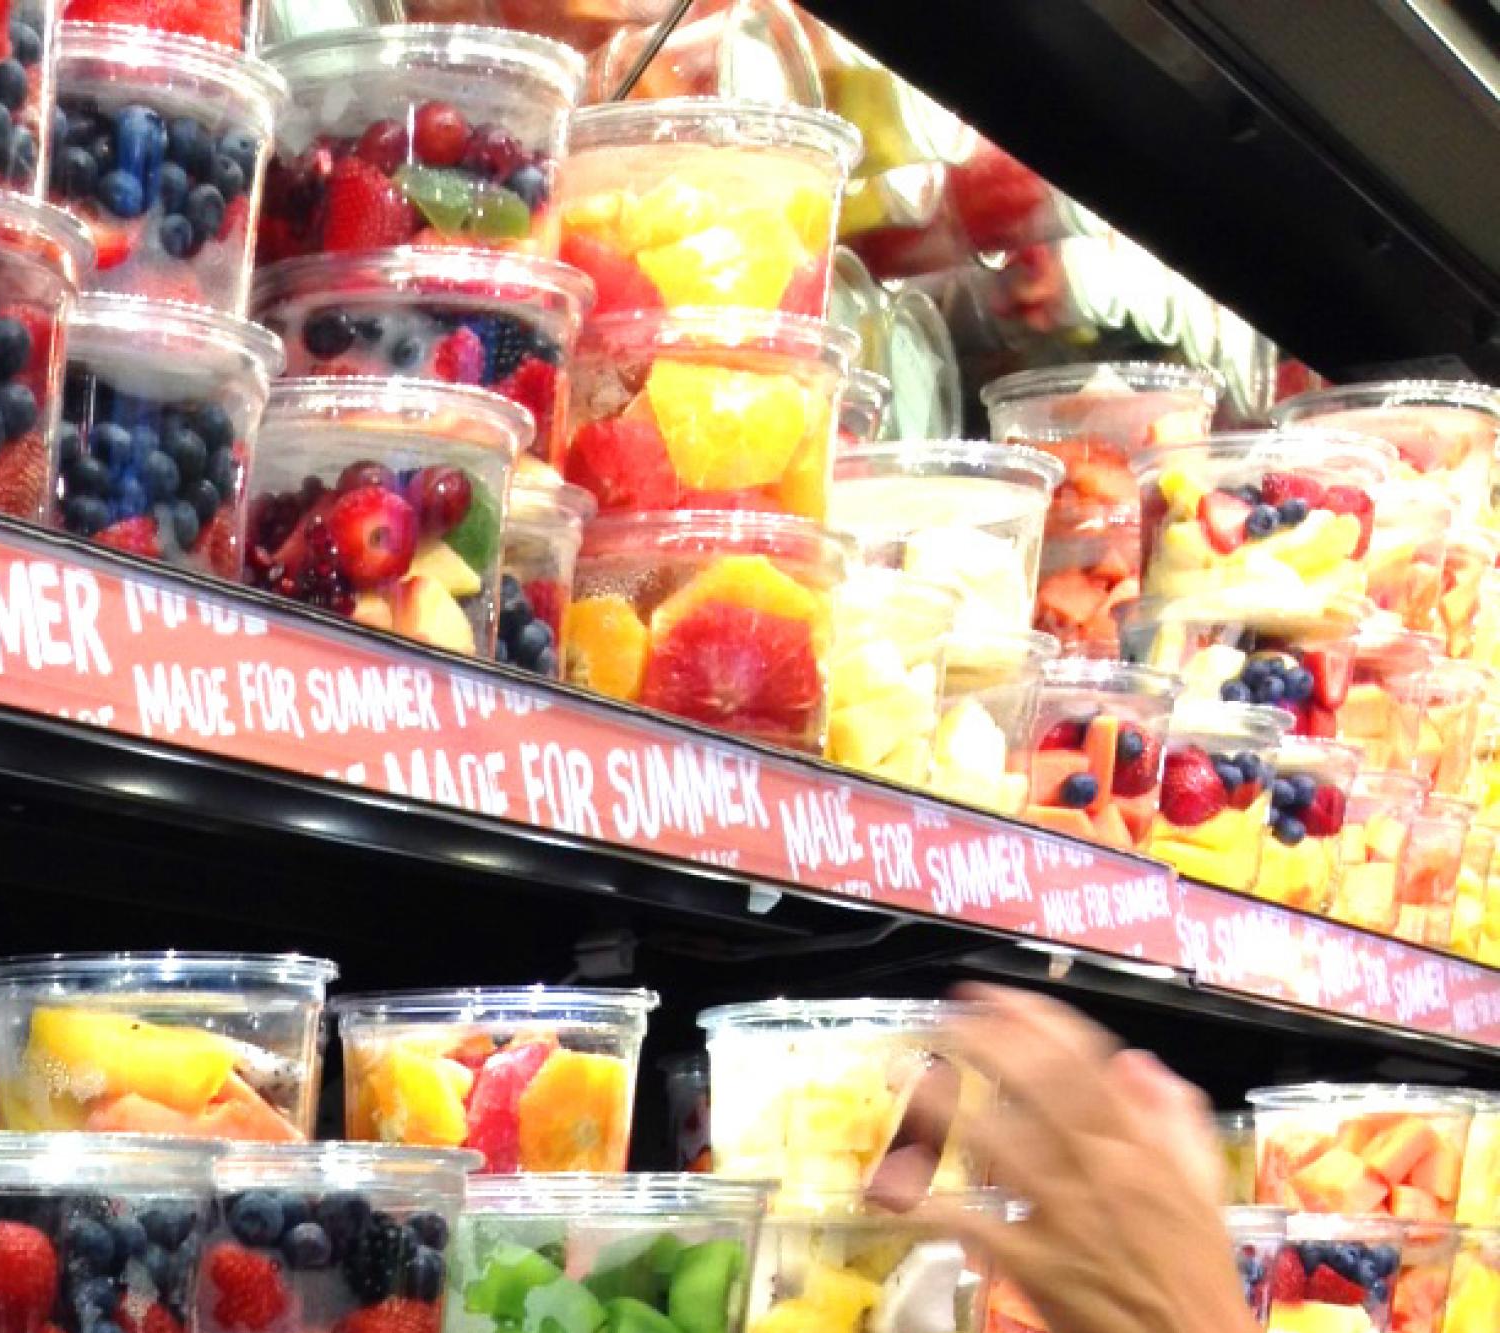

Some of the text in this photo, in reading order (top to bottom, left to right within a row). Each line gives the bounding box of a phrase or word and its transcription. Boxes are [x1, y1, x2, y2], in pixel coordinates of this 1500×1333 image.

[133, 660, 235, 737] MADE
[238, 662, 304, 738] FOR
[306, 665, 440, 734] SUMMER
[519, 743, 602, 840] FOR
[607, 744, 770, 840] SUMMER
[779, 785, 863, 880] MADE
[868, 824, 921, 890] FOR
[925, 833, 1031, 914] SUMMER
